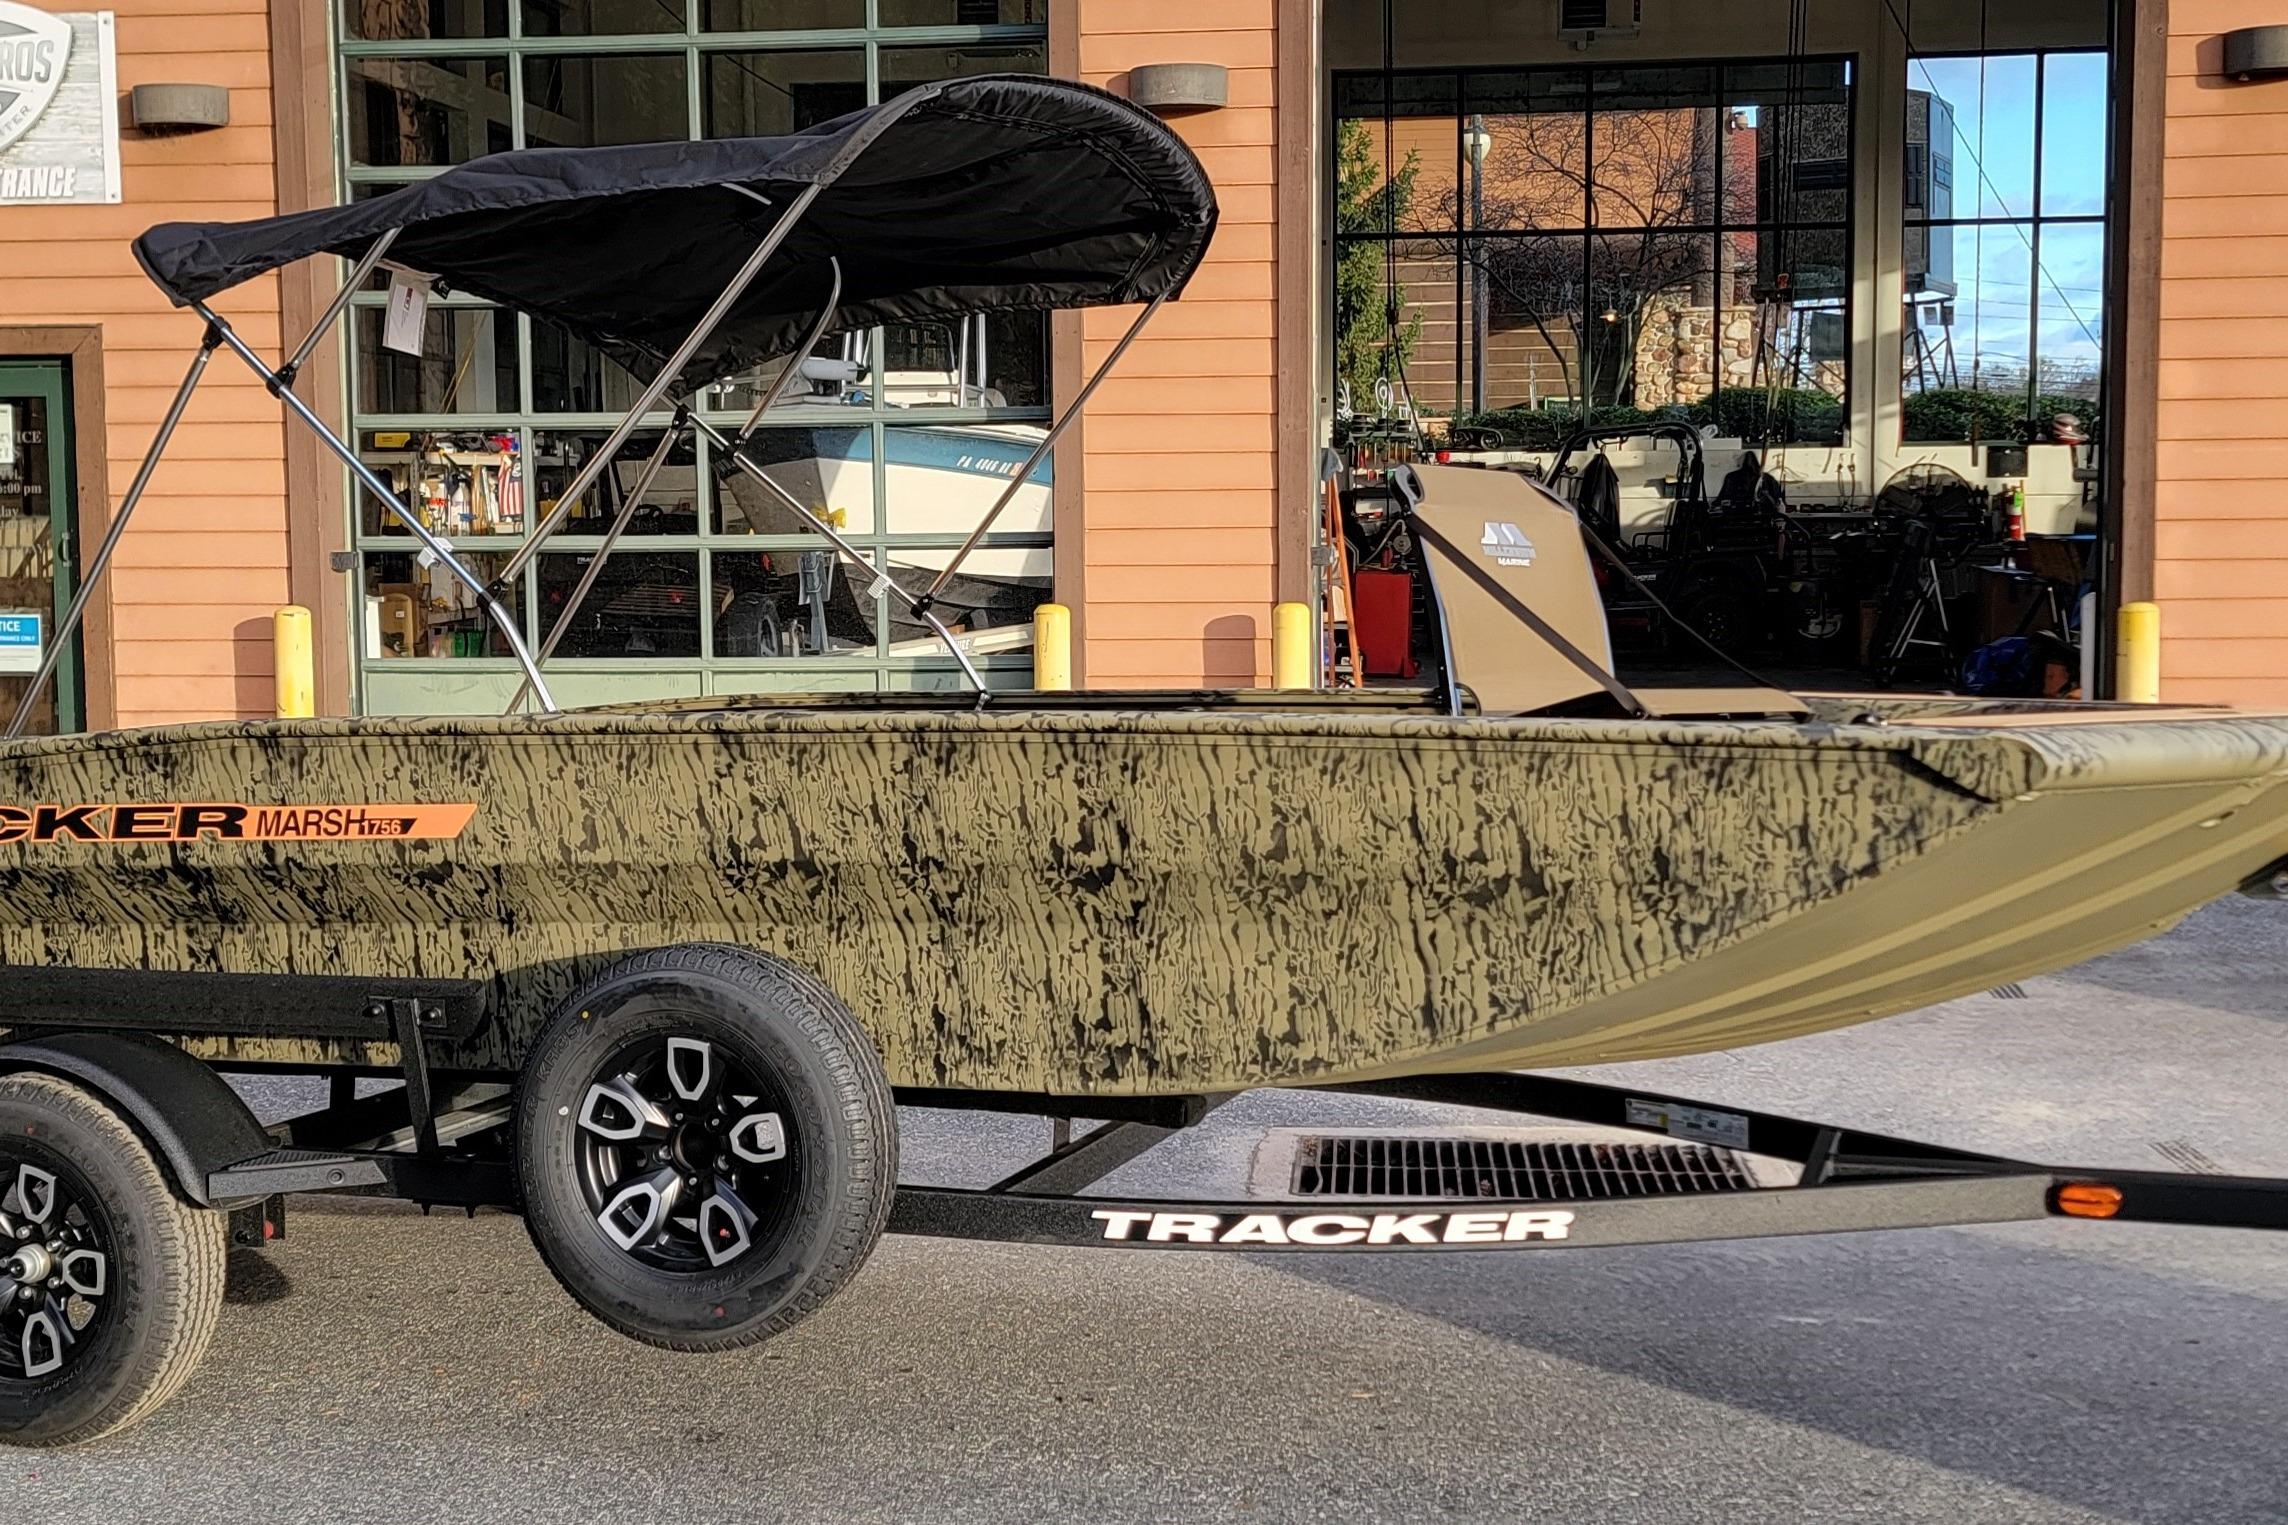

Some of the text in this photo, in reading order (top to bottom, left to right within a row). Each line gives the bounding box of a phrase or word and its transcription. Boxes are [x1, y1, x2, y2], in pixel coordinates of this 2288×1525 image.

[0, 166, 76, 197] RANCE
[23, 485, 42, 496] pm
[255, 808, 367, 838] MARSH
[363, 820, 402, 835] 1756
[1091, 1210, 1575, 1245] TRACKER
